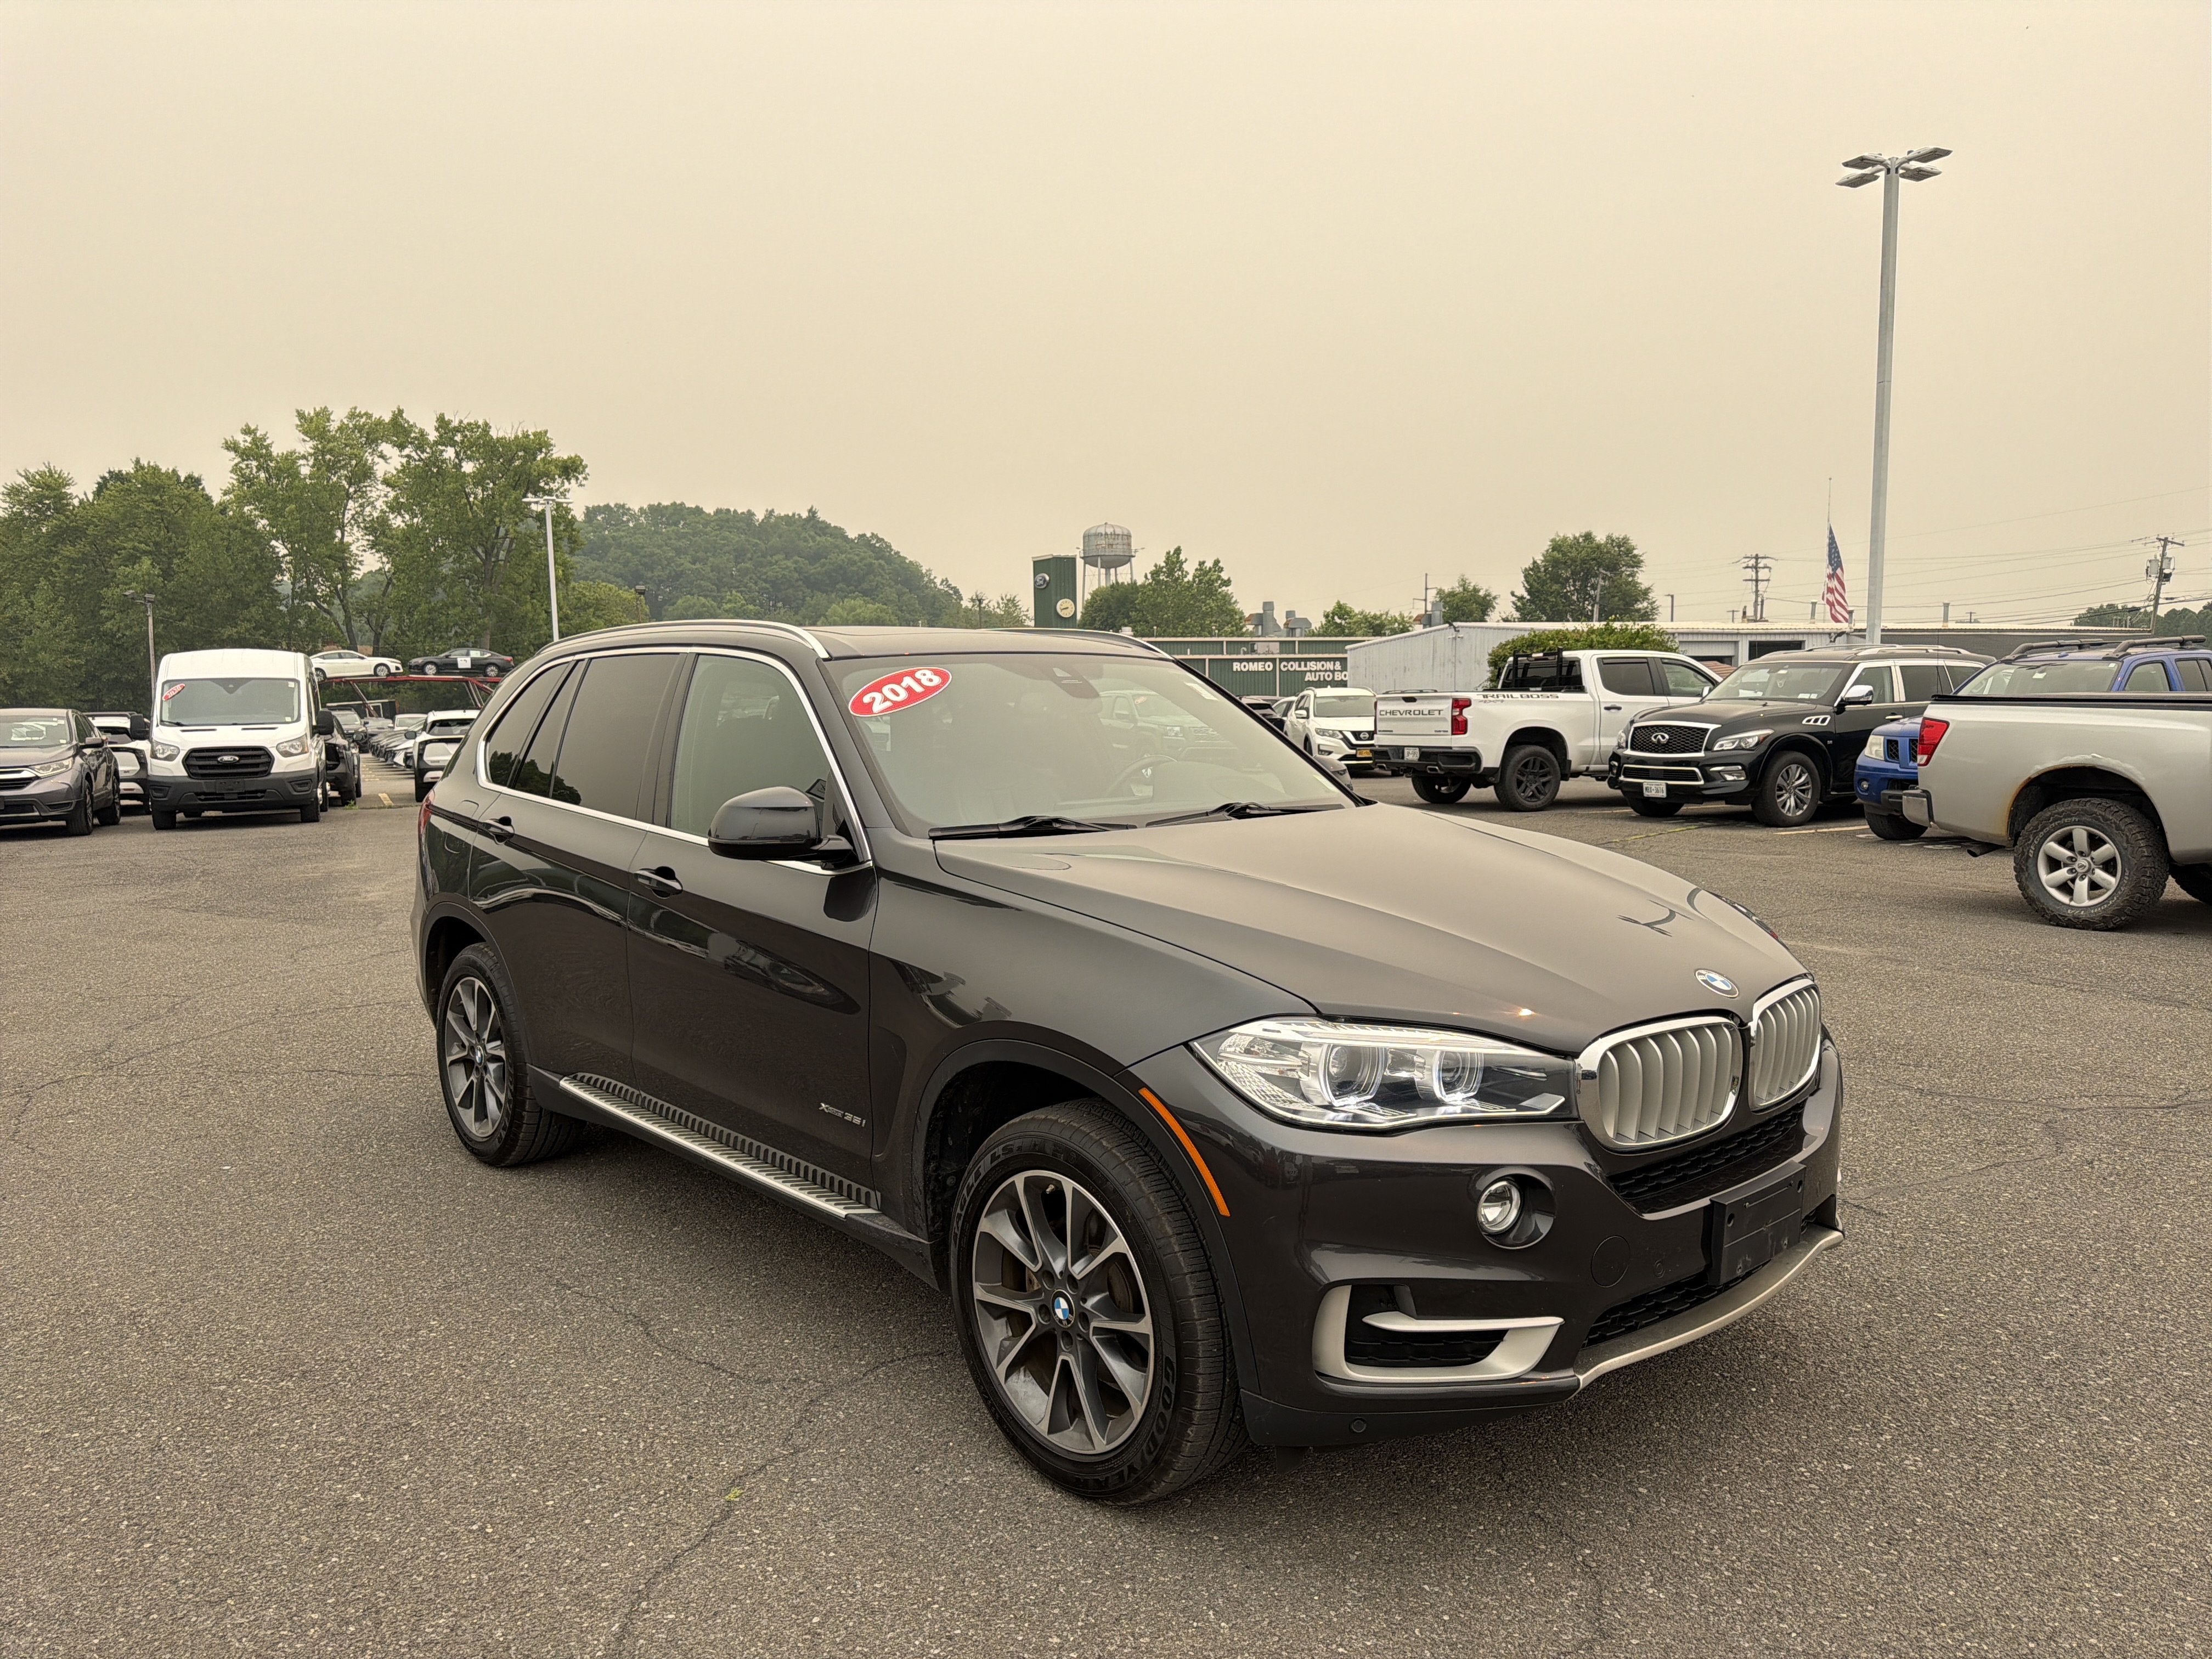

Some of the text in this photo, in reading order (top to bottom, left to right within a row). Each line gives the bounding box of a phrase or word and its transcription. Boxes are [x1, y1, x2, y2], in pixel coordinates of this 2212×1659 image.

[1233, 662, 1273, 672] ROMEO
[1280, 661, 1334, 671] COLLISION
[1305, 672, 1333, 681] AUTO
[862, 669, 942, 713] 2018
